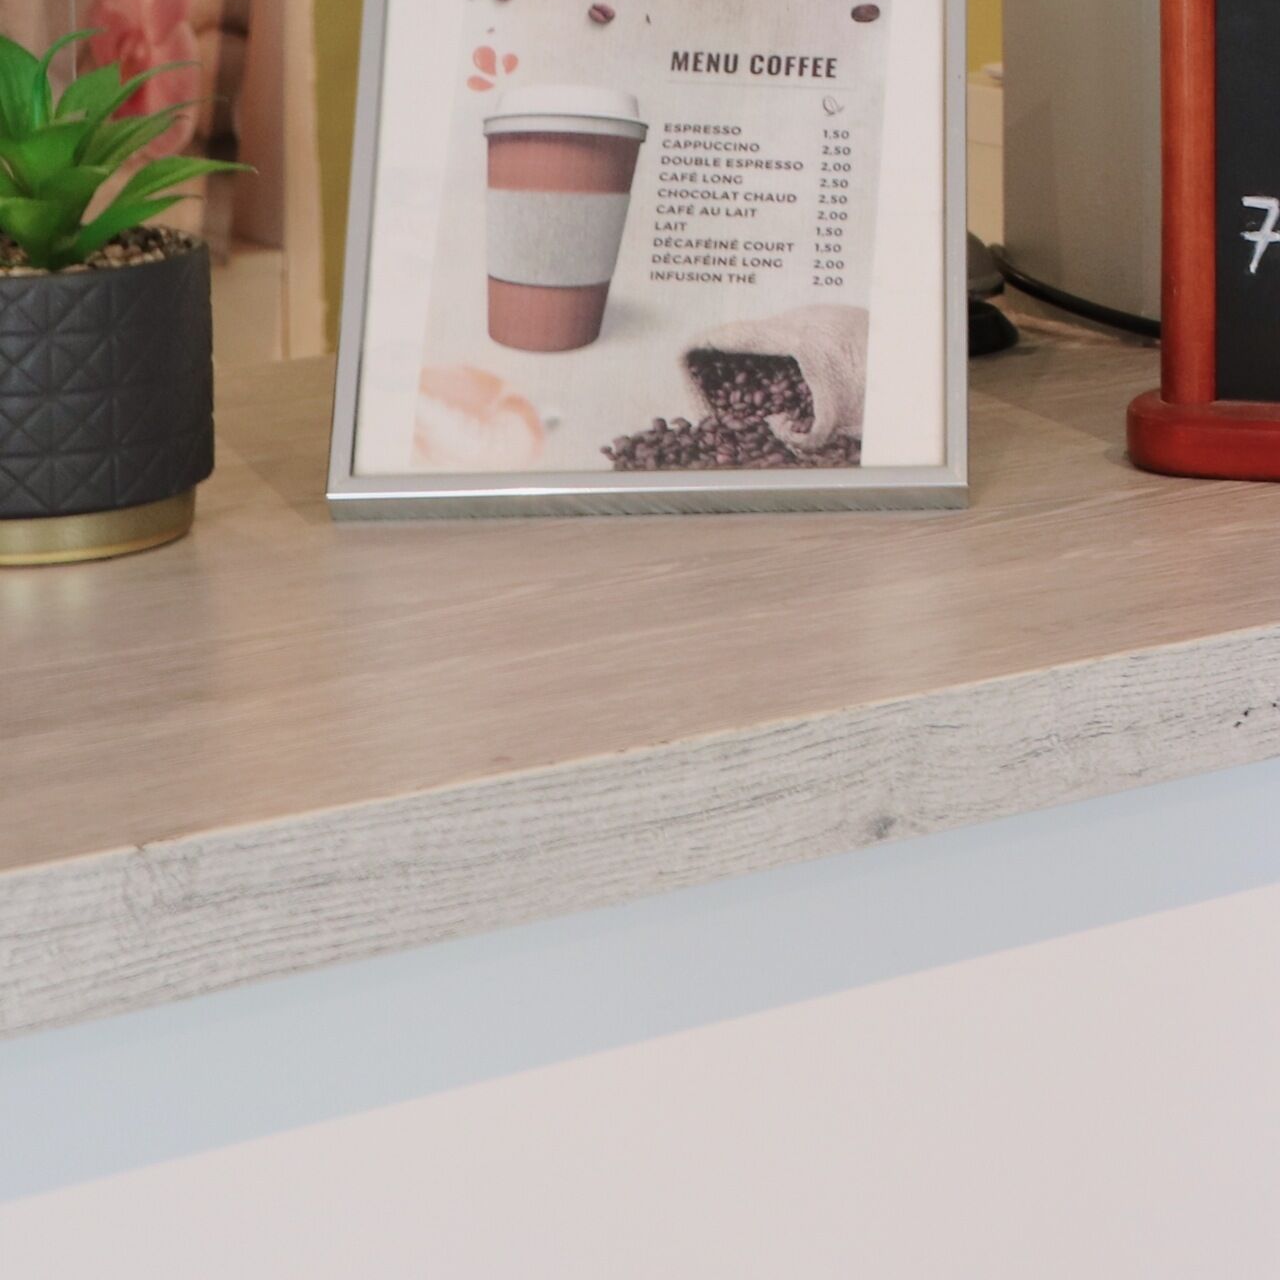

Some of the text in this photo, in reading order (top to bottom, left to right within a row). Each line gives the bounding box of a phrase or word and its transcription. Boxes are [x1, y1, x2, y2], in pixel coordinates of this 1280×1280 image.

[670, 51, 838, 78] MENU COFFEE
[664, 123, 742, 136] ESPRESSO
[662, 140, 760, 152] CAPPUCCINO
[661, 156, 721, 168] DOUBLE
[726, 158, 804, 170] ESPRESSO
[659, 172, 697, 183] CAFÉ
[702, 174, 743, 185] LONG
[658, 189, 739, 201] CHOCOLAT
[744, 192, 797, 204] CHAUD
[656, 204, 695, 215] CAFÉ
[700, 207, 721, 216] AU
[725, 208, 757, 217] LAIT
[655, 222, 688, 232] LAIT
[653, 236, 739, 250] DÉCAFÉINÉ
[744, 241, 795, 253] COURT
[652, 253, 737, 266] DÉCAFÉINÉ
[742, 257, 783, 268] LONG
[650, 271, 722, 283] INFUSION
